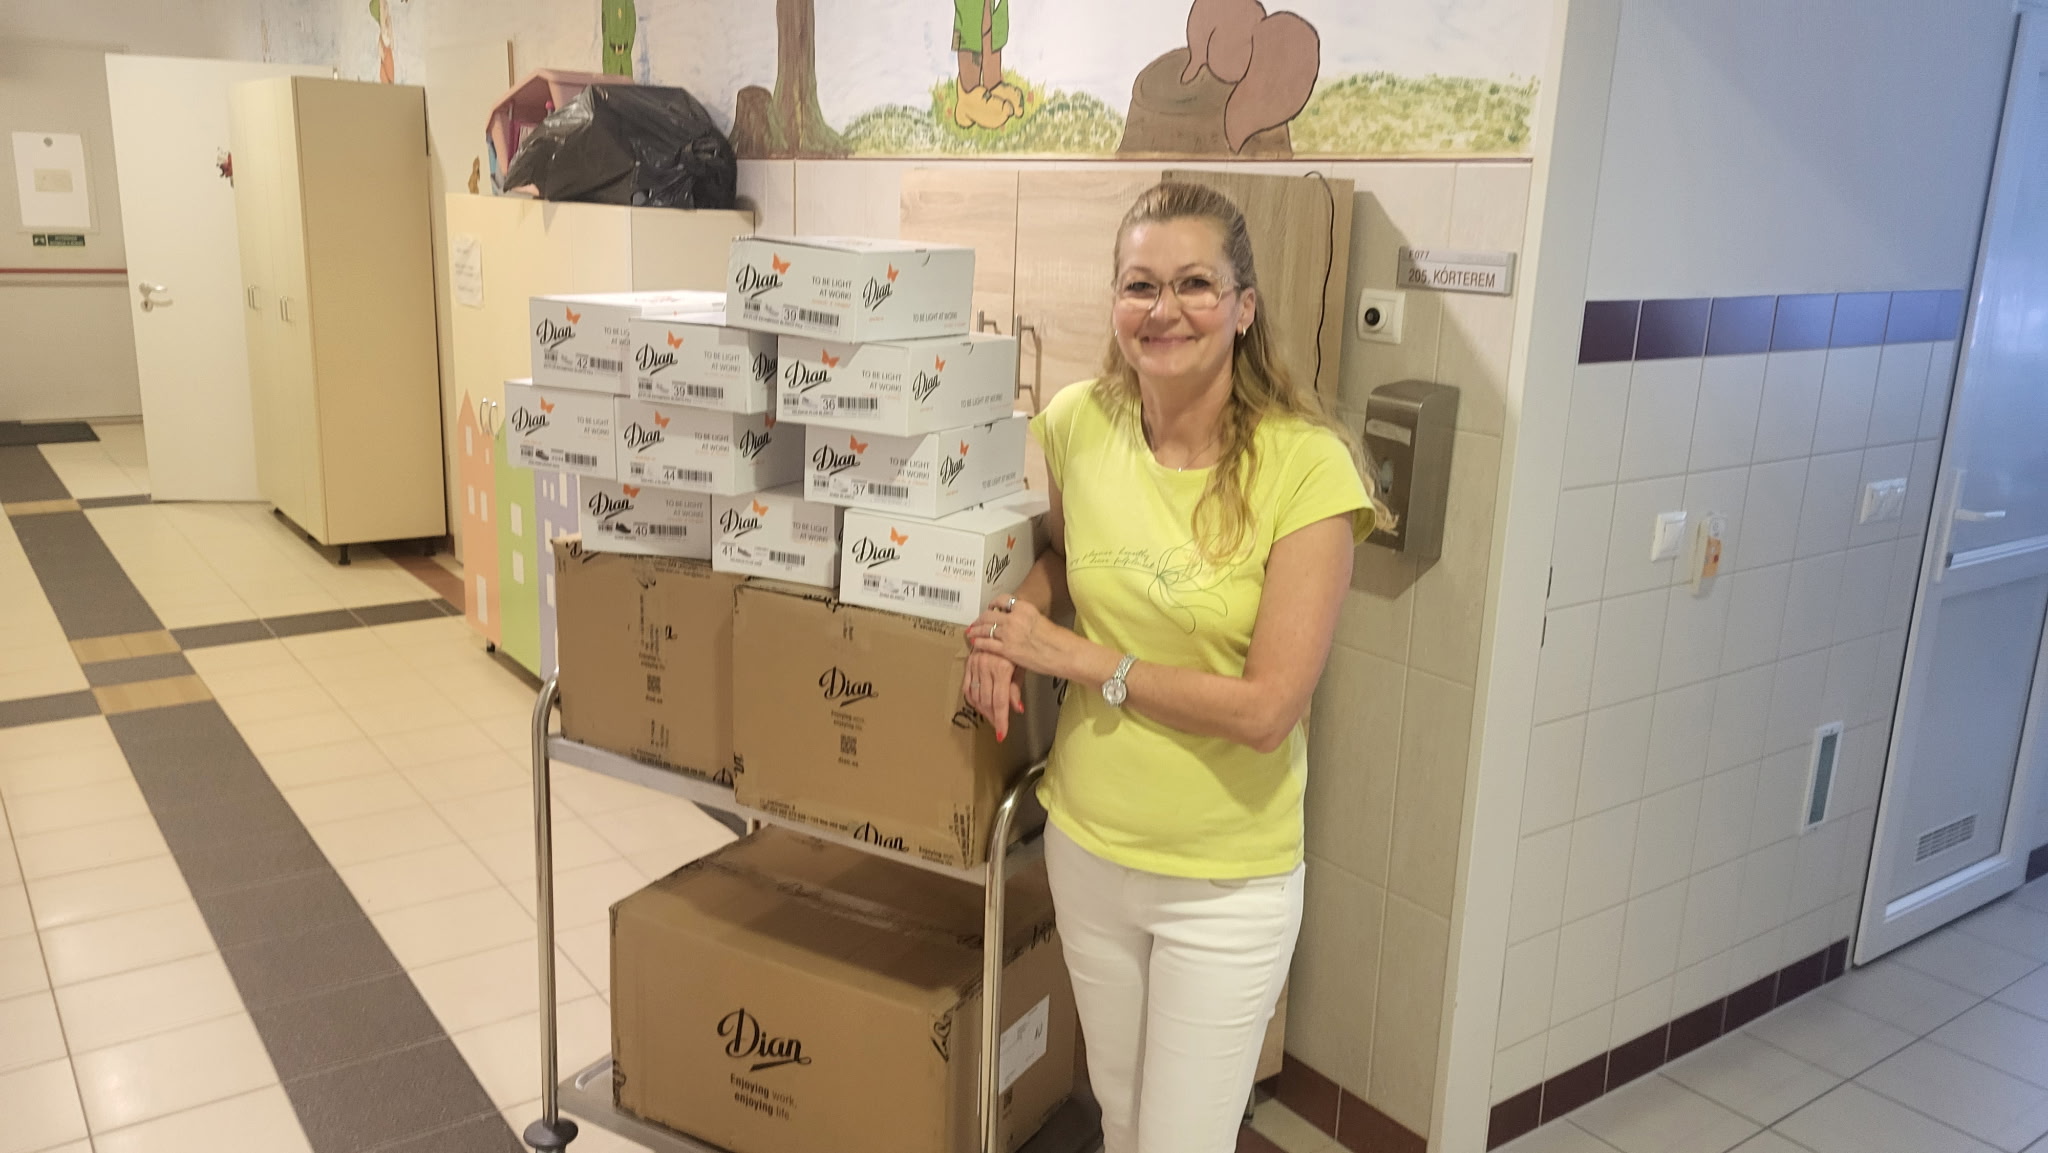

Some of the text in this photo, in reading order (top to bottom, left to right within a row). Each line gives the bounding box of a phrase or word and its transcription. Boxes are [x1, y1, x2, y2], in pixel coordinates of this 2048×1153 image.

[736, 264, 783, 300] Dian
[1433, 264, 1496, 288] KÓRTEREM
[863, 277, 892, 312] Dian
[783, 308, 798, 323] 39
[536, 318, 576, 352] Dian
[577, 357, 588, 369] 42
[636, 343, 678, 377] Dian
[752, 351, 777, 385] Dia
[673, 384, 686, 398] 39
[785, 360, 832, 394] Dian
[912, 370, 940, 405] Dian
[823, 398, 836, 411] 36
[512, 406, 550, 437] Dian
[624, 422, 664, 453] Dian
[740, 429, 772, 461] Dian
[813, 444, 860, 476] Dian
[940, 455, 965, 488] Dian
[589, 491, 634, 521] Dian
[635, 525, 648, 537] 40
[720, 507, 762, 539] Dian
[722, 545, 734, 558] 41
[852, 536, 900, 570] Dian
[986, 553, 1011, 585] Dian
[904, 584, 916, 599] 41
[819, 666, 879, 708] Dian
[717, 1008, 812, 1073] Dian
[730, 1072, 769, 1100] Enjoying
[734, 1091, 773, 1118] enjoying
